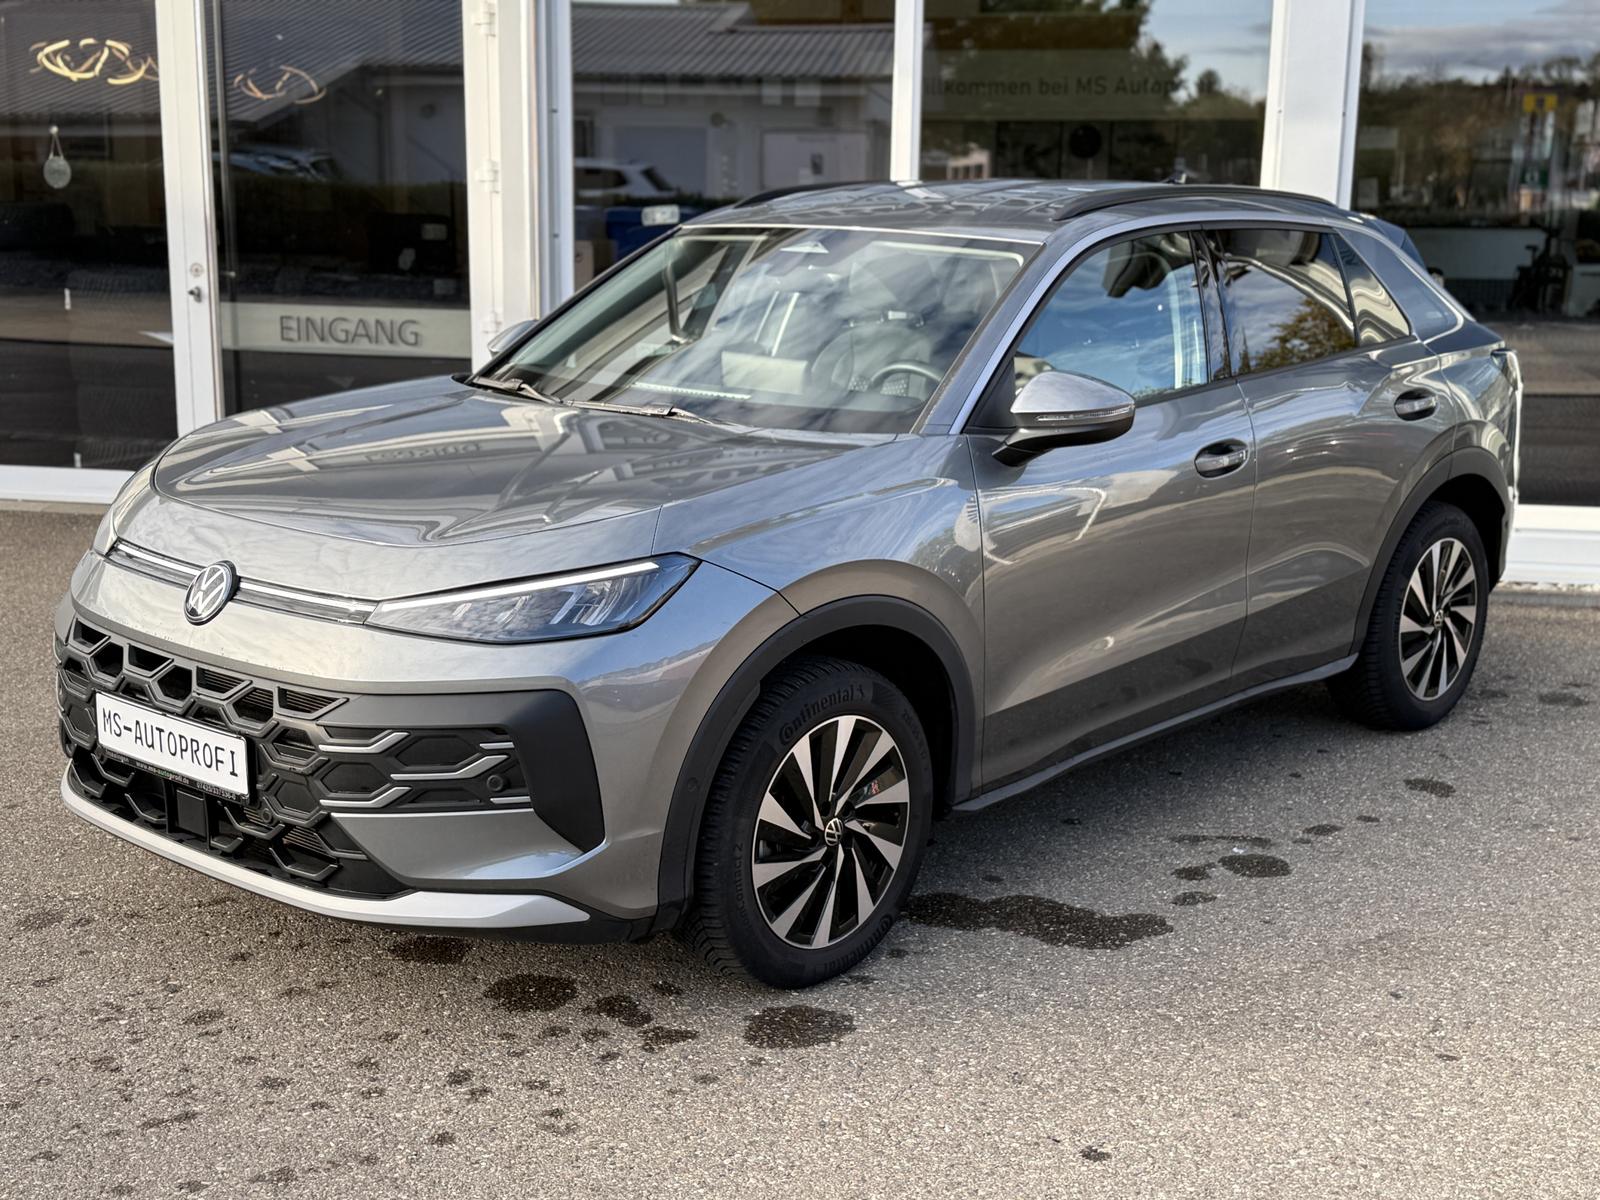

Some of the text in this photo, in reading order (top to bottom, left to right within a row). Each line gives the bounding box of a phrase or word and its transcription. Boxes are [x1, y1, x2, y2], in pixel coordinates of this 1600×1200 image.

[921, 76, 1032, 96] illkommen
[1038, 76, 1069, 96] bei
[1075, 76, 1108, 96] MS
[279, 315, 421, 347] EINGANG
[779, 684, 855, 746] Continental
[102, 707, 239, 778] MS-AUTOPROFI
